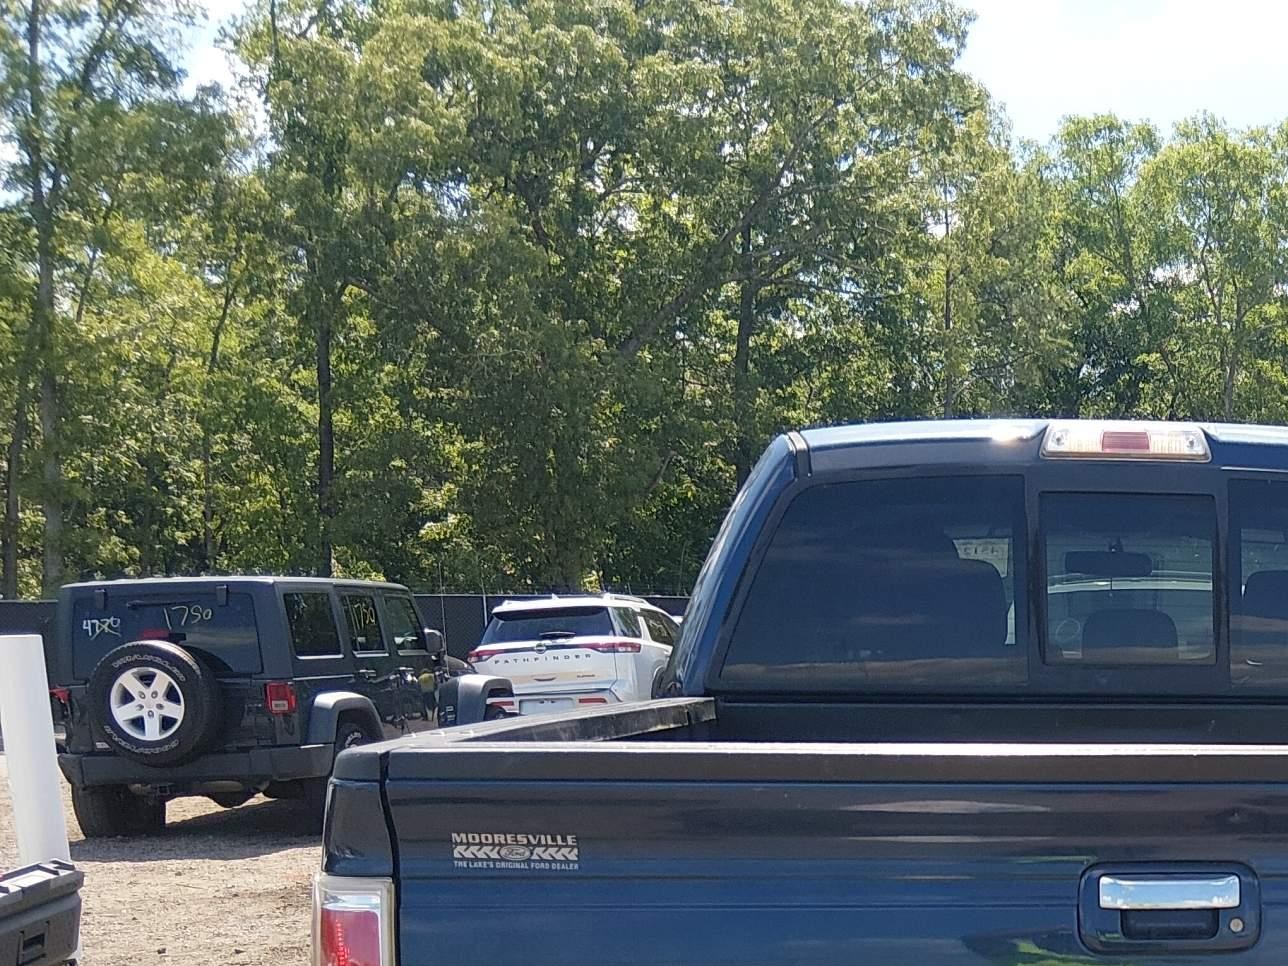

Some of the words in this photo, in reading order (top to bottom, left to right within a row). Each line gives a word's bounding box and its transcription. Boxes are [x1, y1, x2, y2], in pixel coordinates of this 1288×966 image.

[494, 653, 592, 664] PATHFINDER
[451, 832, 578, 846] MOORESVILLE
[453, 860, 467, 868] THE
[469, 861, 494, 869] LAKE'S
[496, 861, 529, 869] ORIGINAL
[531, 862, 550, 870] FORD
[552, 862, 579, 870] DEALER
